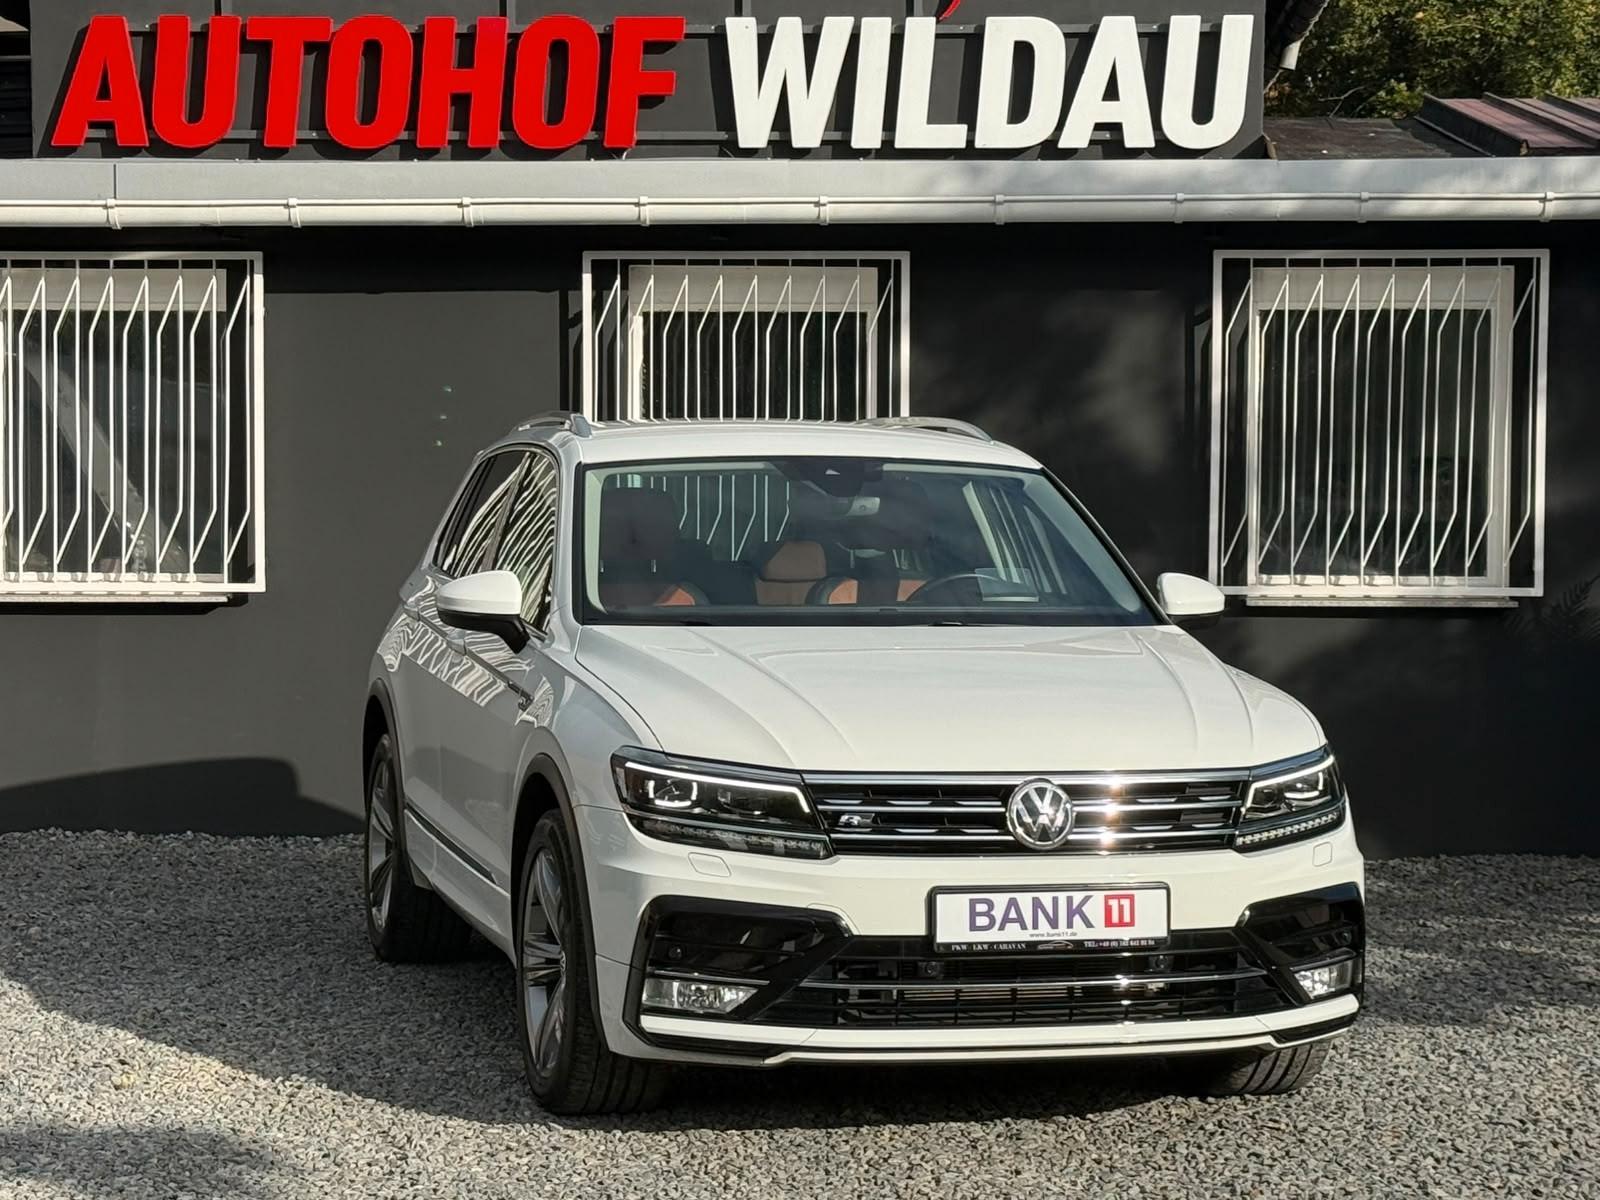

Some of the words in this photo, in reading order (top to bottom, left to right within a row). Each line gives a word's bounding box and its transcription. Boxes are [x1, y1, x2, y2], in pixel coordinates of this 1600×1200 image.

[51, 15, 685, 149] AUTOHOF
[725, 14, 1254, 149] WILDAU
[968, 895, 1095, 932] BANK
[1106, 897, 1133, 925] 11
[994, 942, 1026, 950] CARAVAN
